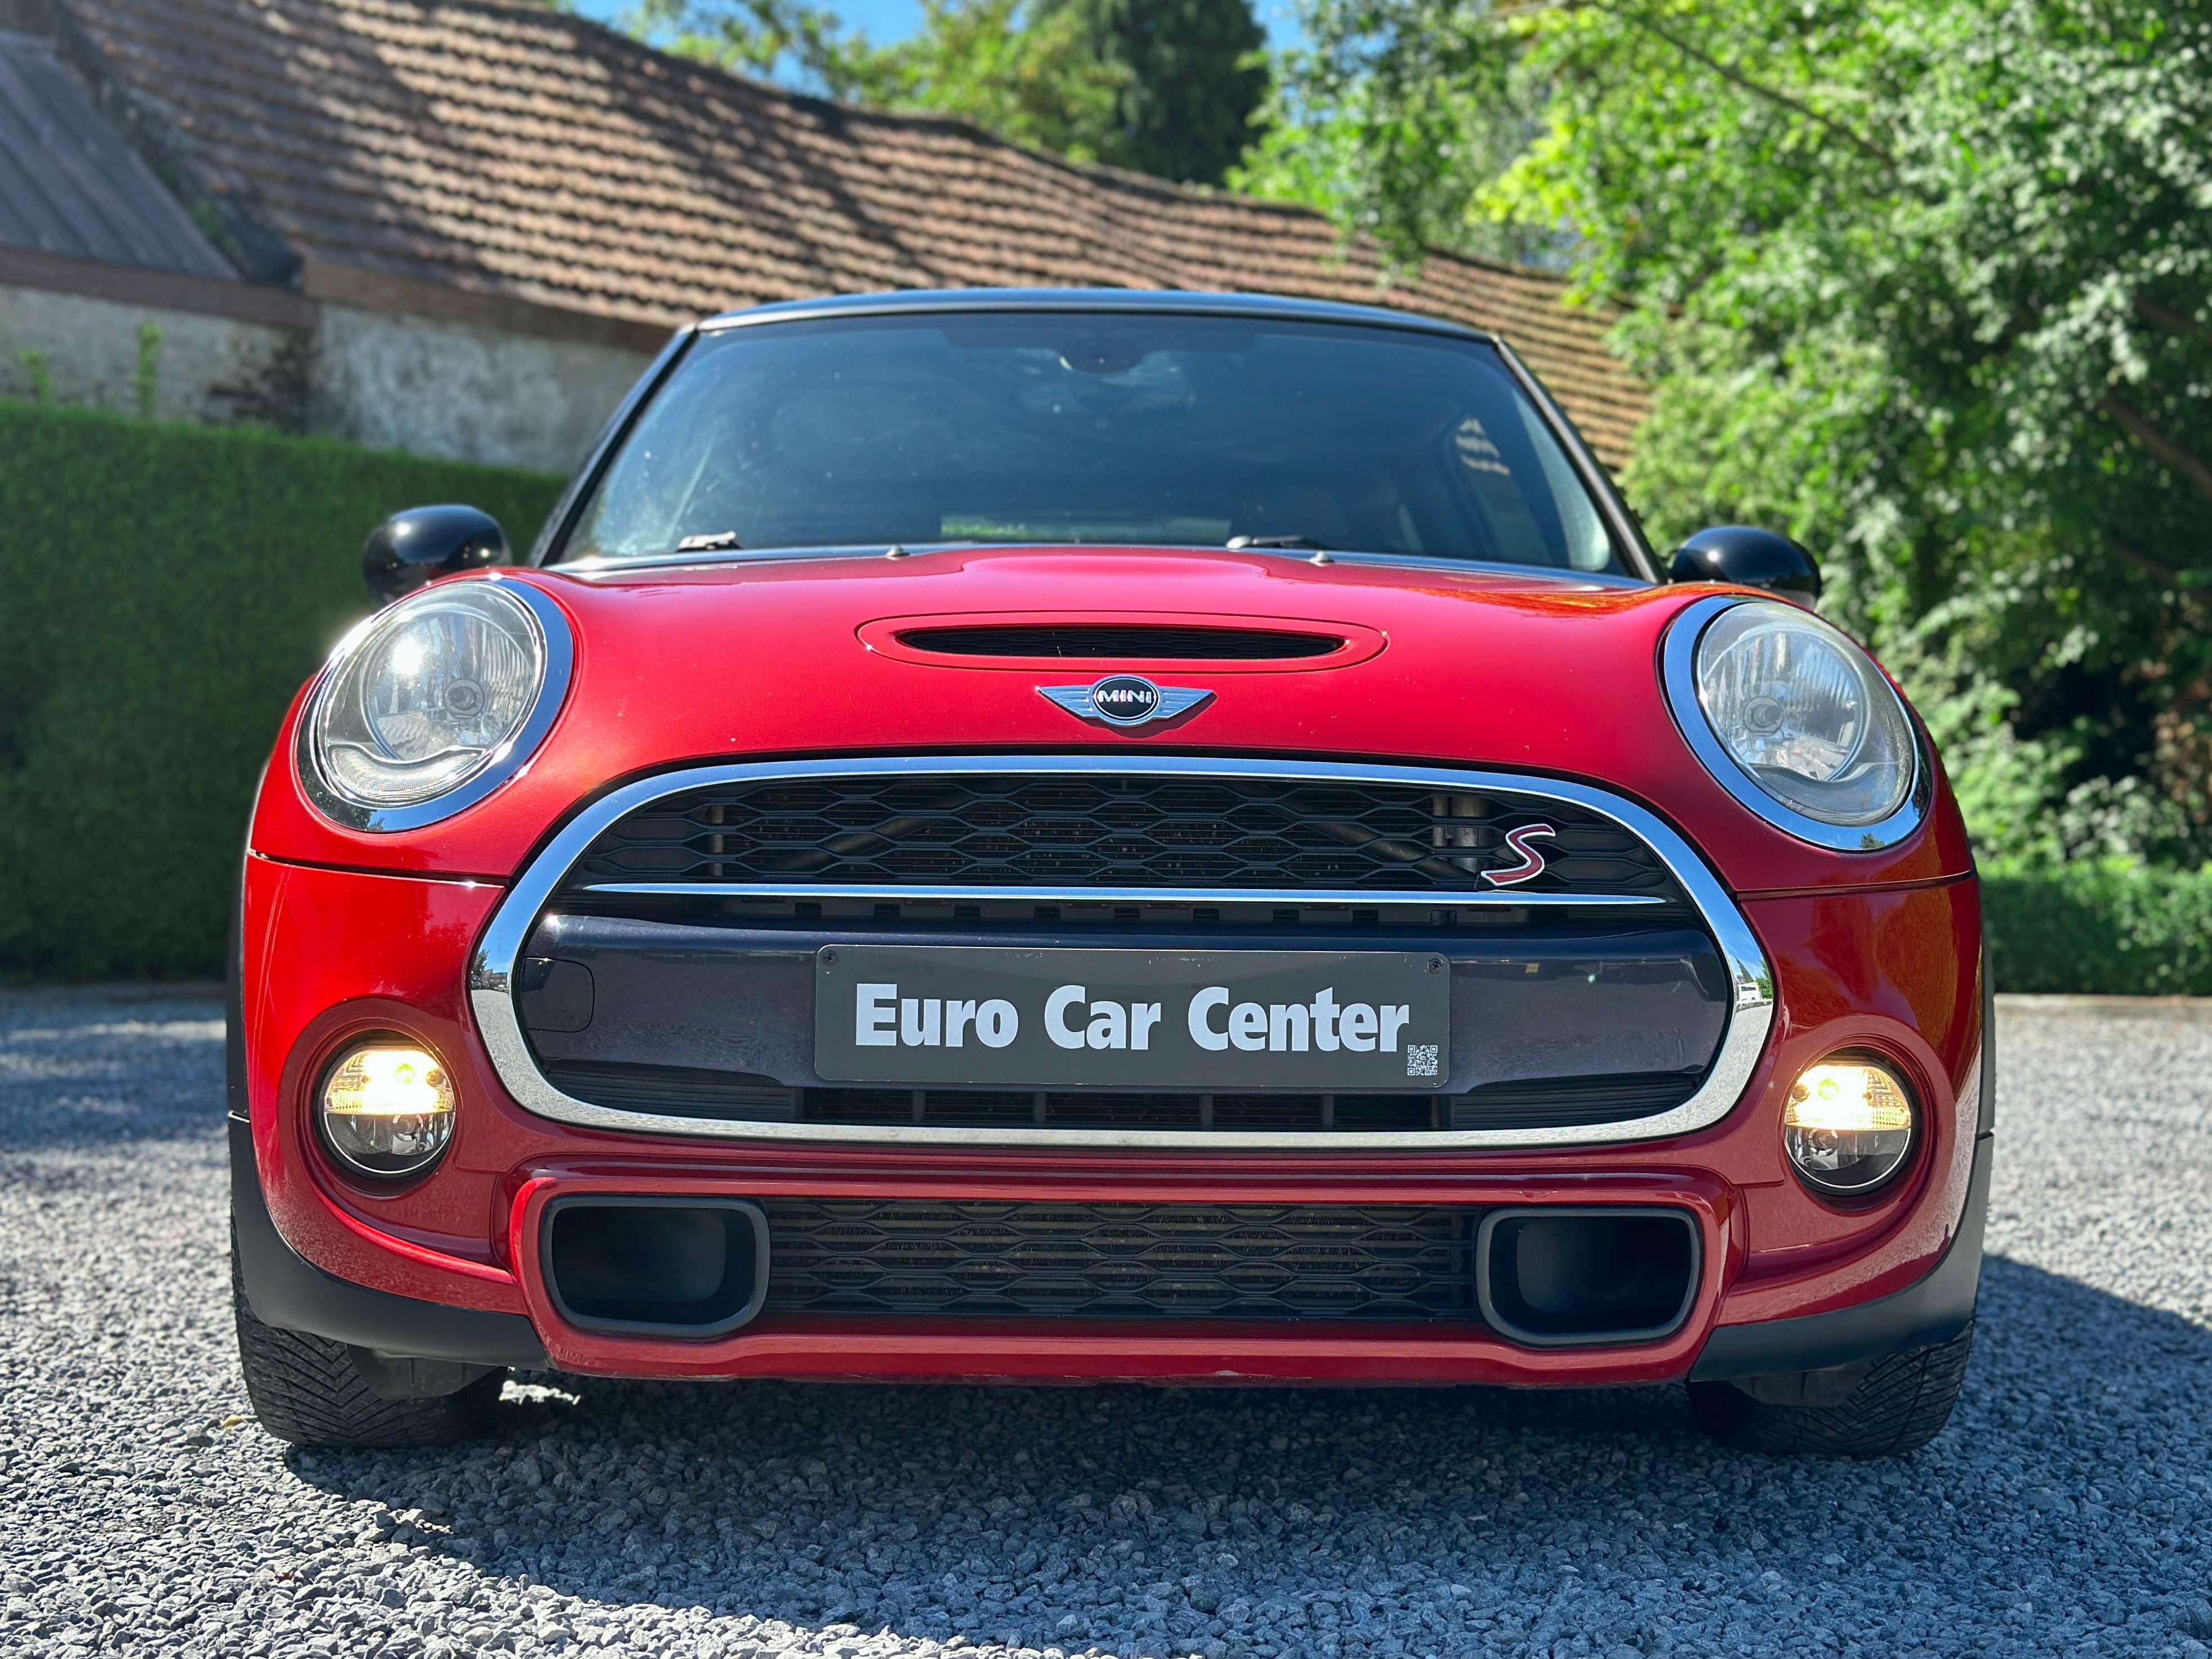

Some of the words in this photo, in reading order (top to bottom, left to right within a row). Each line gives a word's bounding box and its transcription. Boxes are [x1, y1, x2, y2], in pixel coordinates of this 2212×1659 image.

[1098, 690, 1152, 703] MINI
[1480, 823, 1556, 886] S
[856, 984, 1018, 1047] Euro
[1045, 985, 1161, 1049] Car
[1188, 987, 1409, 1052] Center
